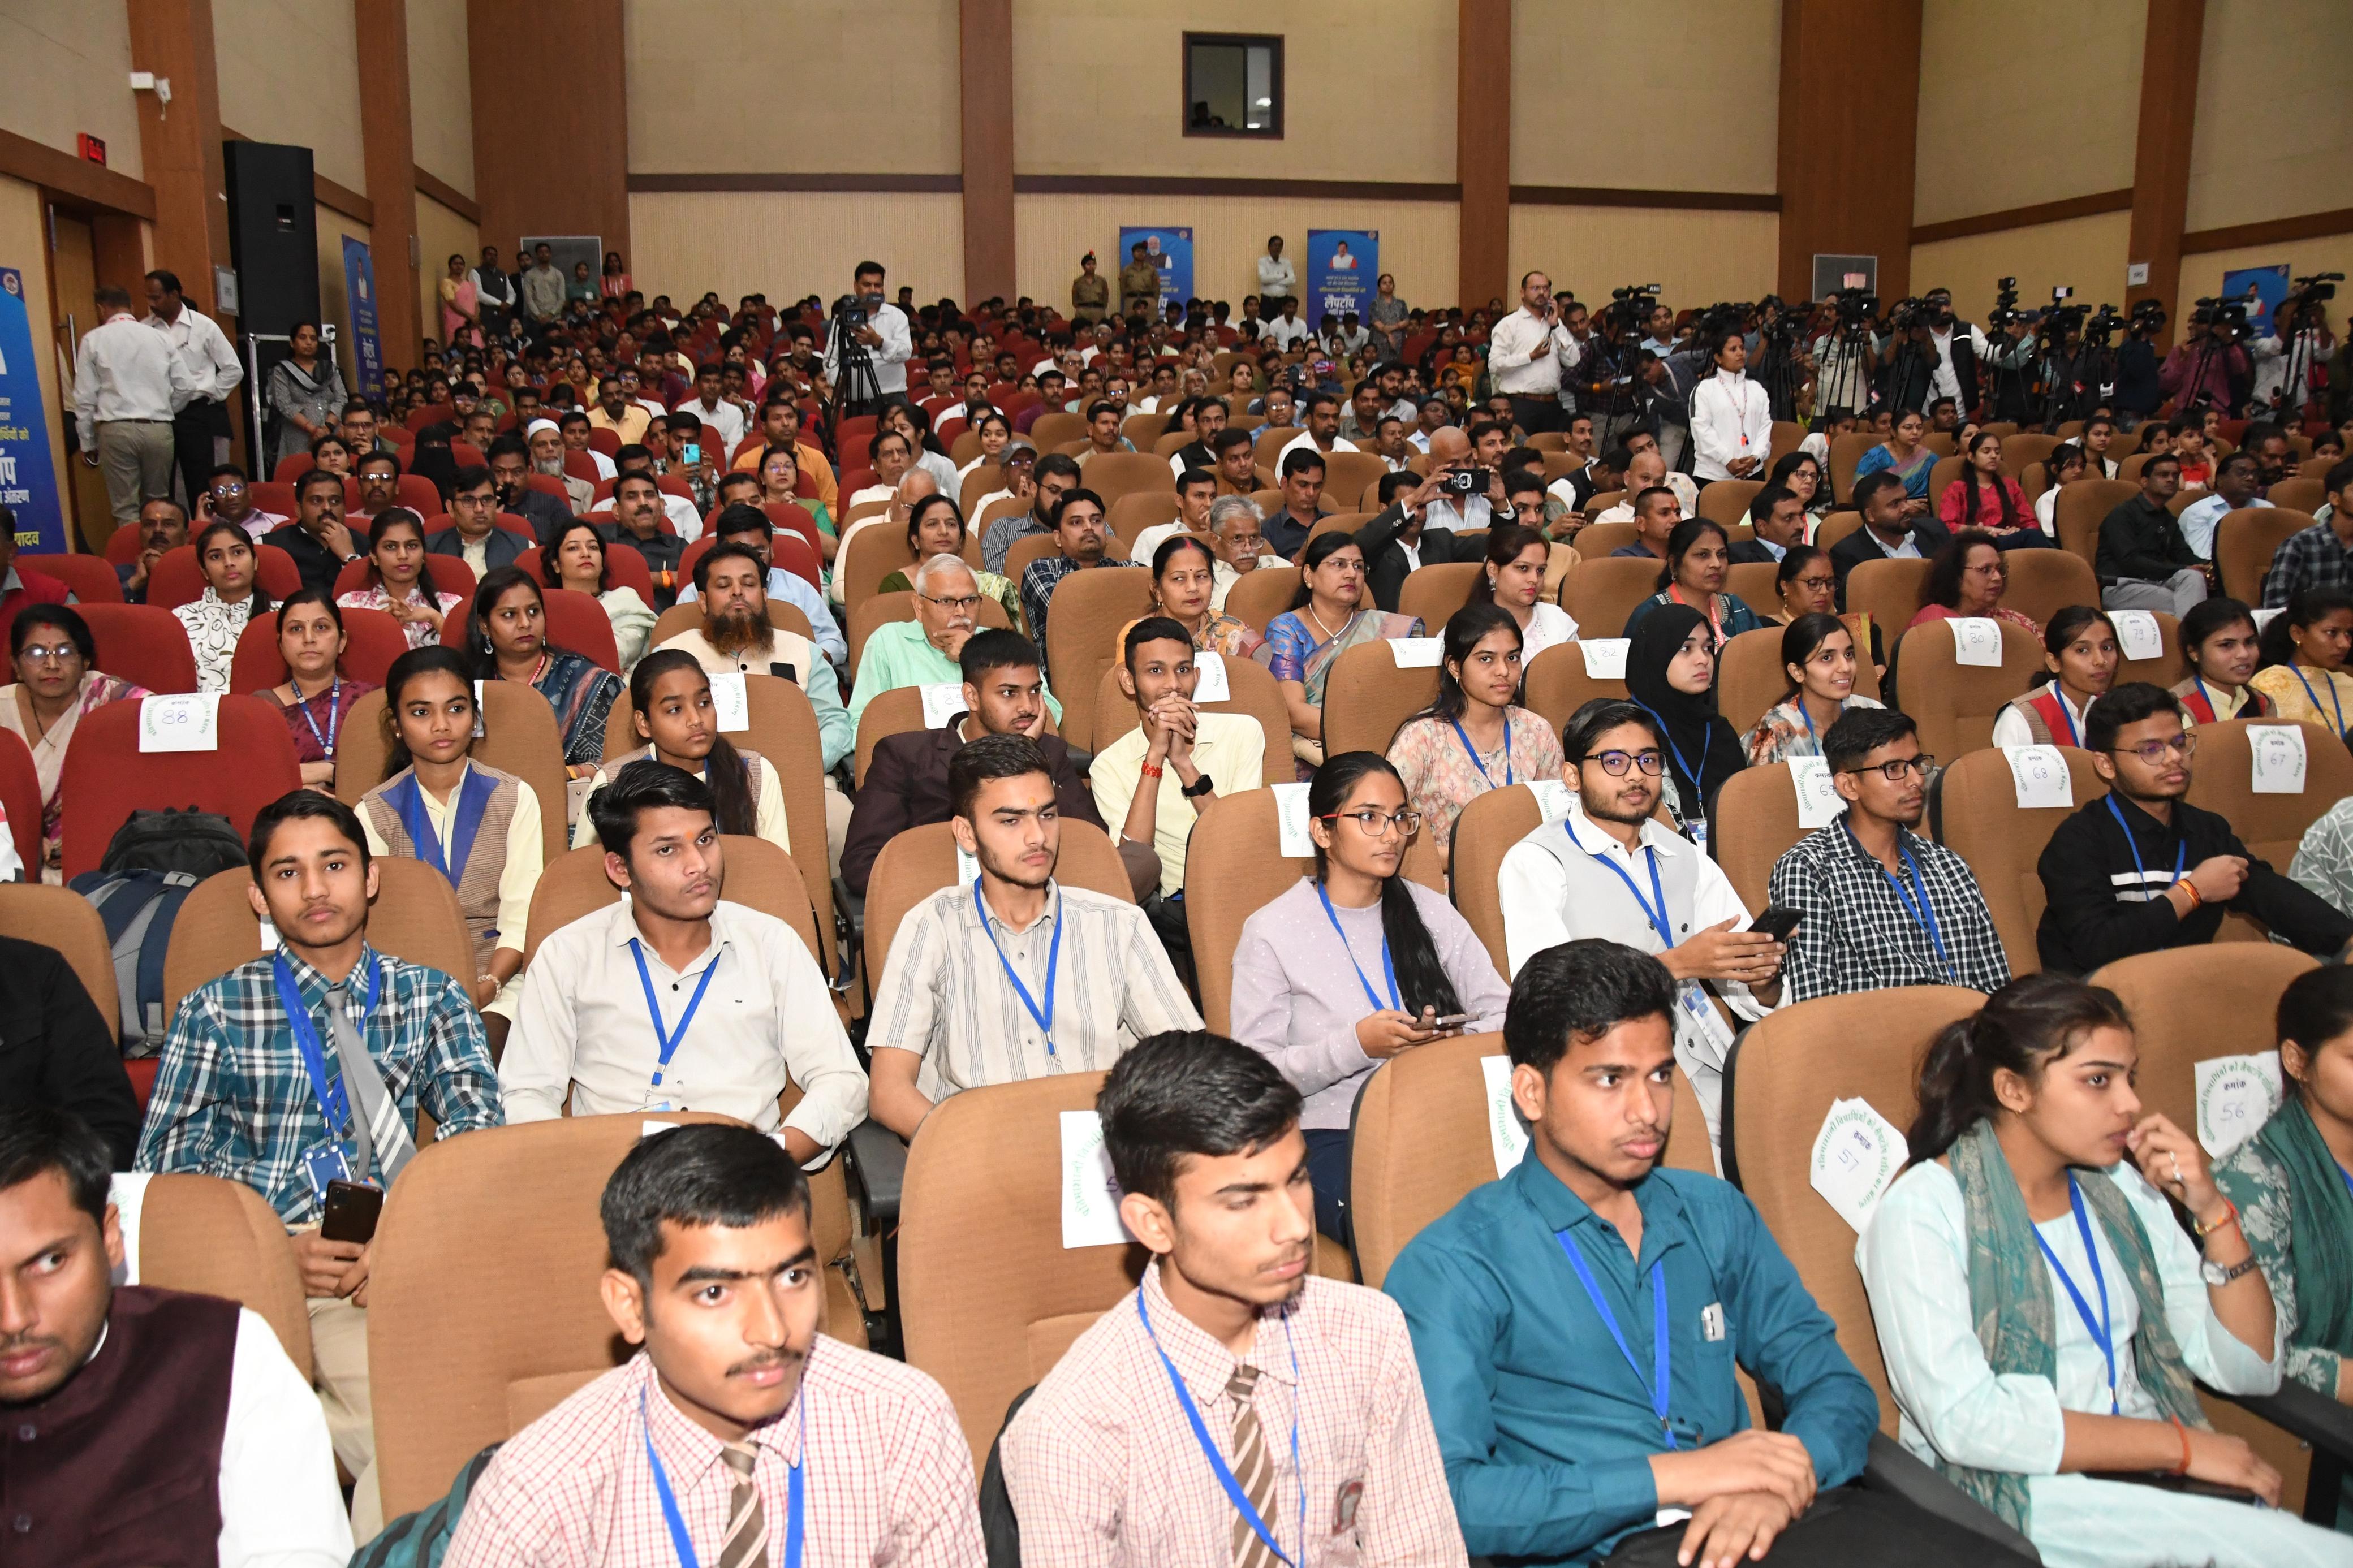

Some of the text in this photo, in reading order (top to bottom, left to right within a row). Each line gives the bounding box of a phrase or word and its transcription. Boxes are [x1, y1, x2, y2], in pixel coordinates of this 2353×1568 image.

[1324, 293, 1356, 309] लैपटॉप
[1969, 632, 1984, 643] 80
[1600, 647, 1619, 658] 82
[162, 710, 188, 724] 88
[2270, 752, 2286, 767] 67
[2032, 766, 2048, 779] 68
[2219, 1101, 2246, 1122] 56
[1837, 1148, 1860, 1173] 57
